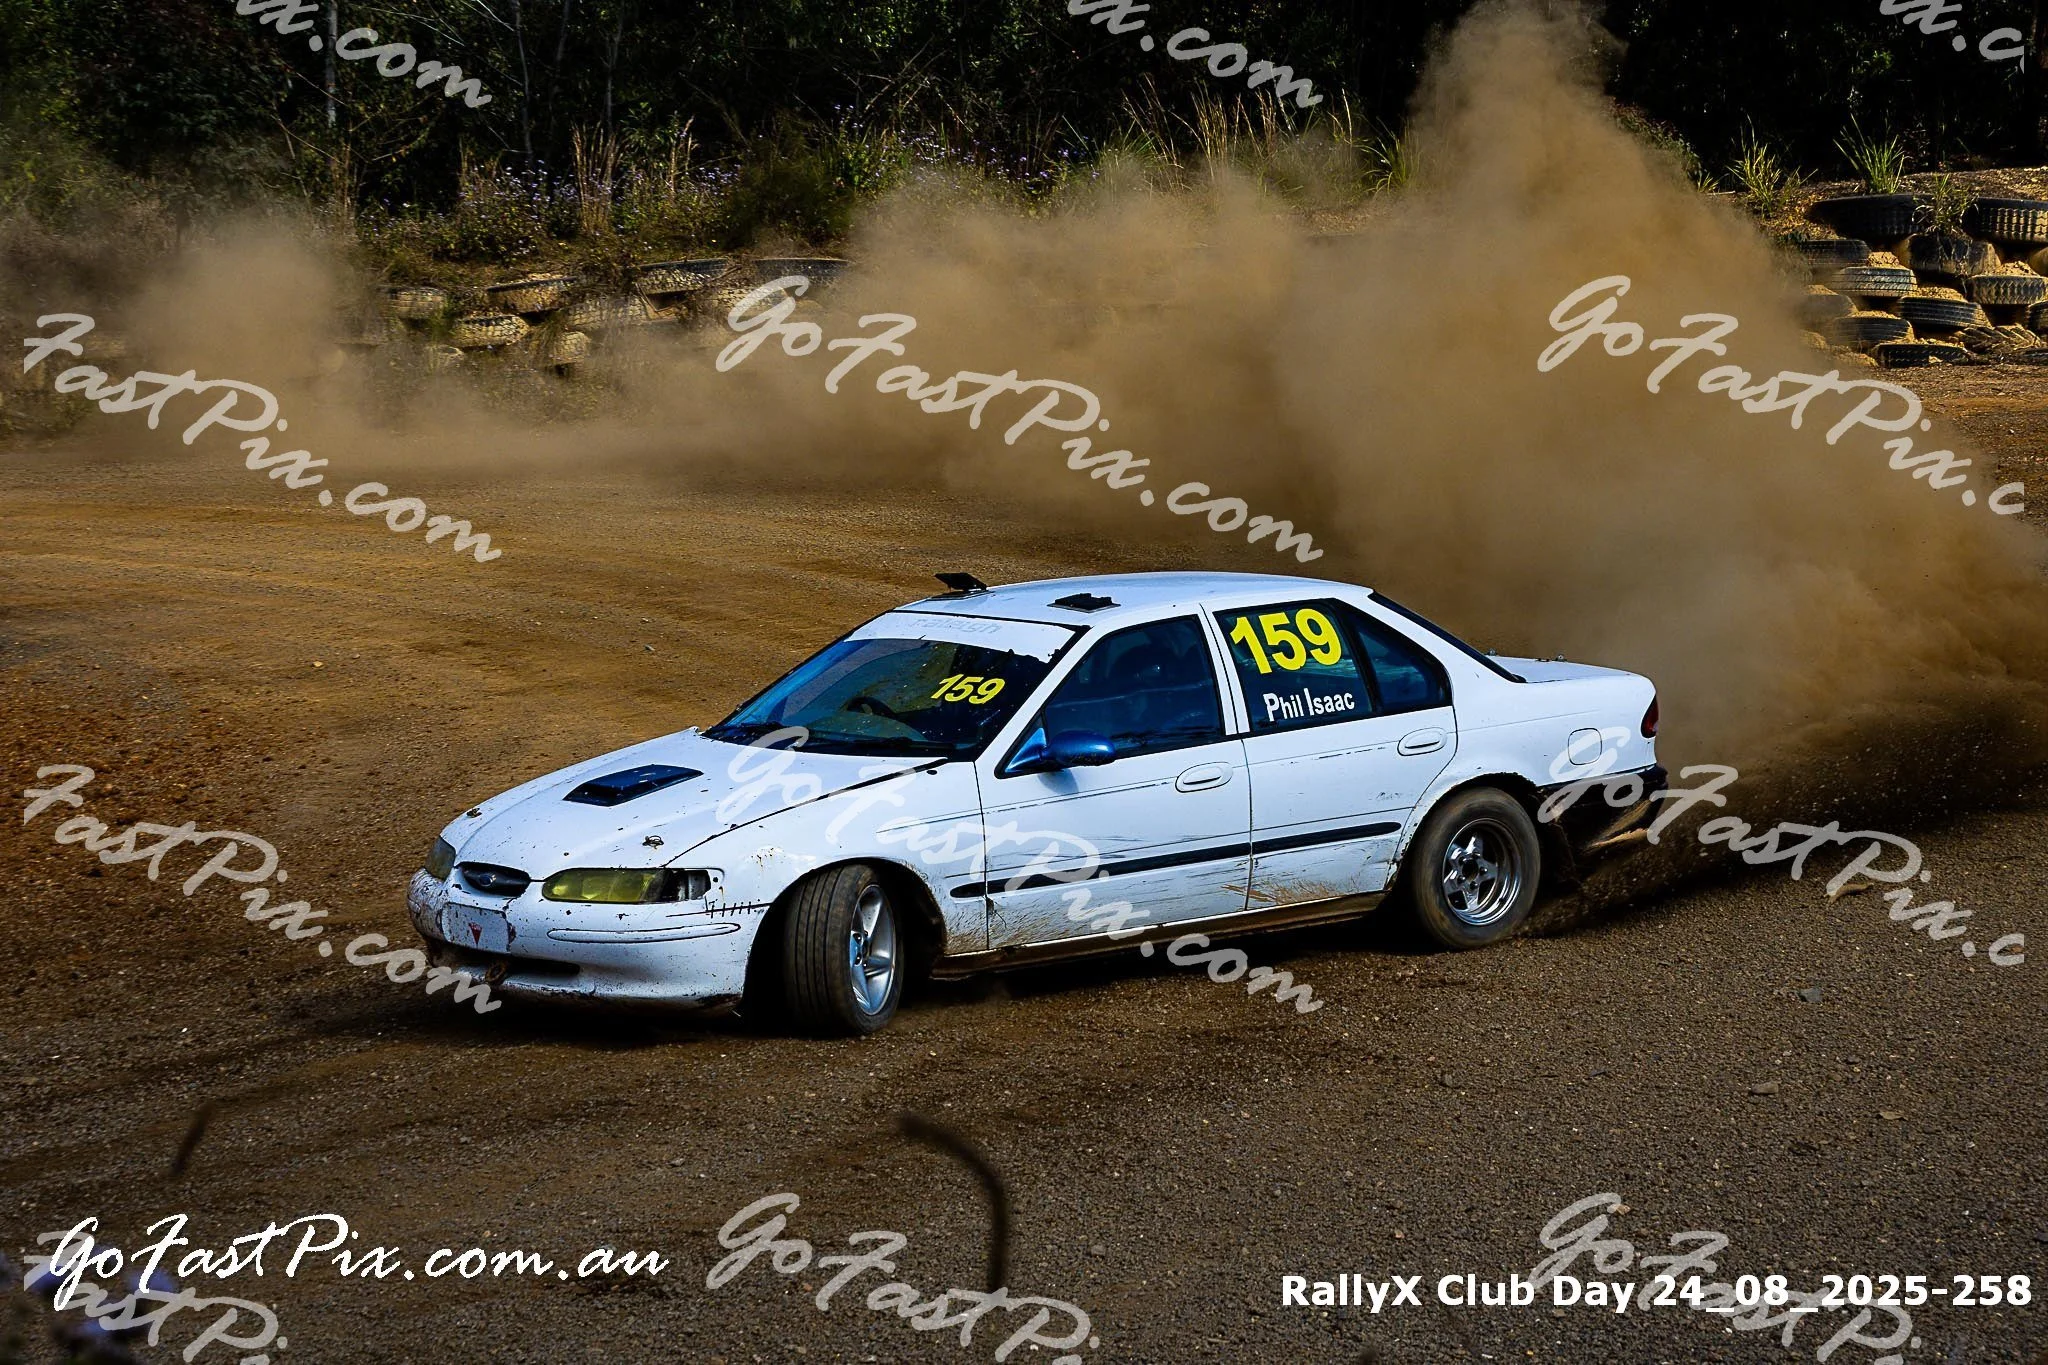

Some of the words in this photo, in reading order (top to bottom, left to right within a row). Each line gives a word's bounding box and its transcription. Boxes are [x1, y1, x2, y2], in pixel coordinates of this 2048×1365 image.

[1229, 608, 1342, 675] 159
[930, 673, 1006, 705] 159
[1262, 692, 1305, 722] Phil
[1303, 687, 1355, 716] Isaac
